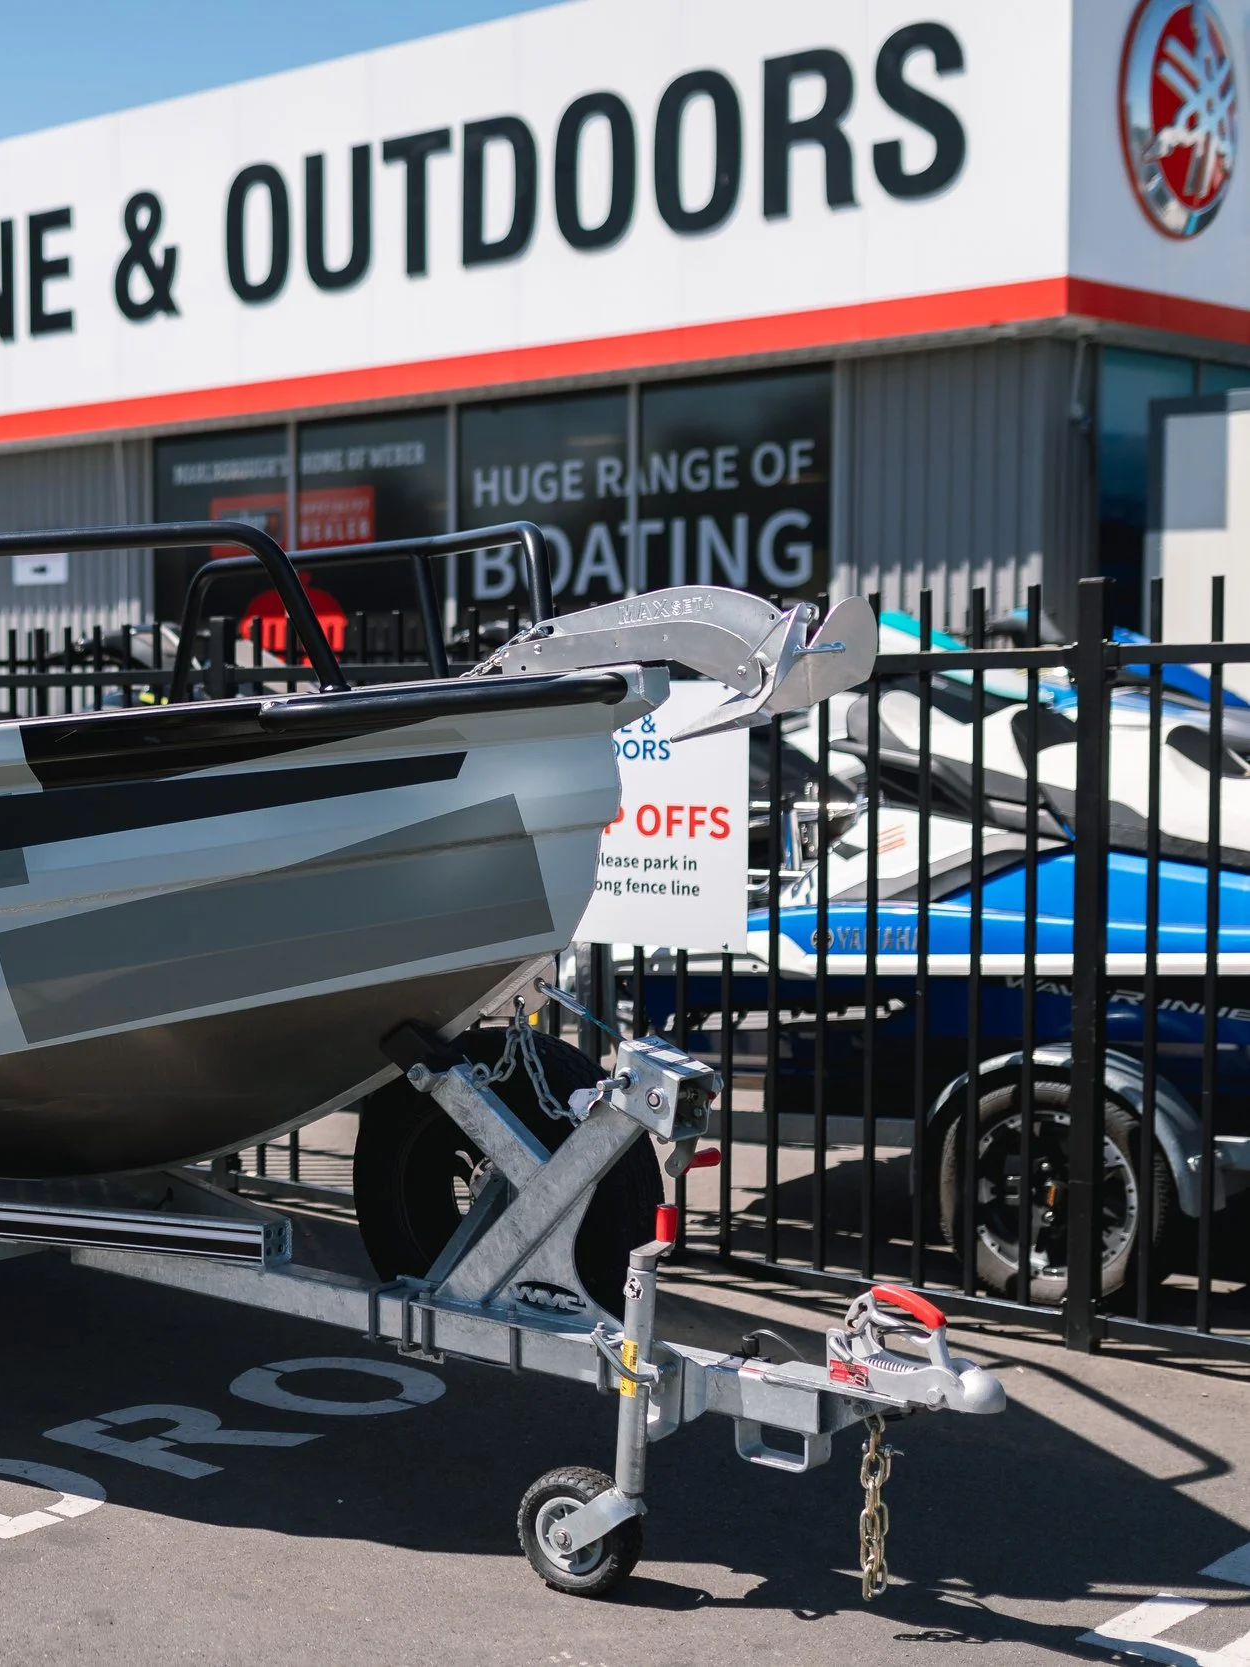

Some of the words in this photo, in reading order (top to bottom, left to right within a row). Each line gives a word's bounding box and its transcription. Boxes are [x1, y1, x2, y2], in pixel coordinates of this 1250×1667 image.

[114, 190, 180, 324] &
[224, 22, 969, 306] OUTDOORS
[472, 459, 584, 508] HUGE
[596, 445, 739, 498] RANGE
[751, 439, 815, 487] OF
[301, 520, 370, 543] DEALER
[473, 509, 813, 601] BOATING
[636, 804, 731, 840] OFFS
[644, 856, 678, 872] park
[683, 857, 697, 871] in
[626, 878, 667, 894] fence
[672, 881, 700, 897] line
